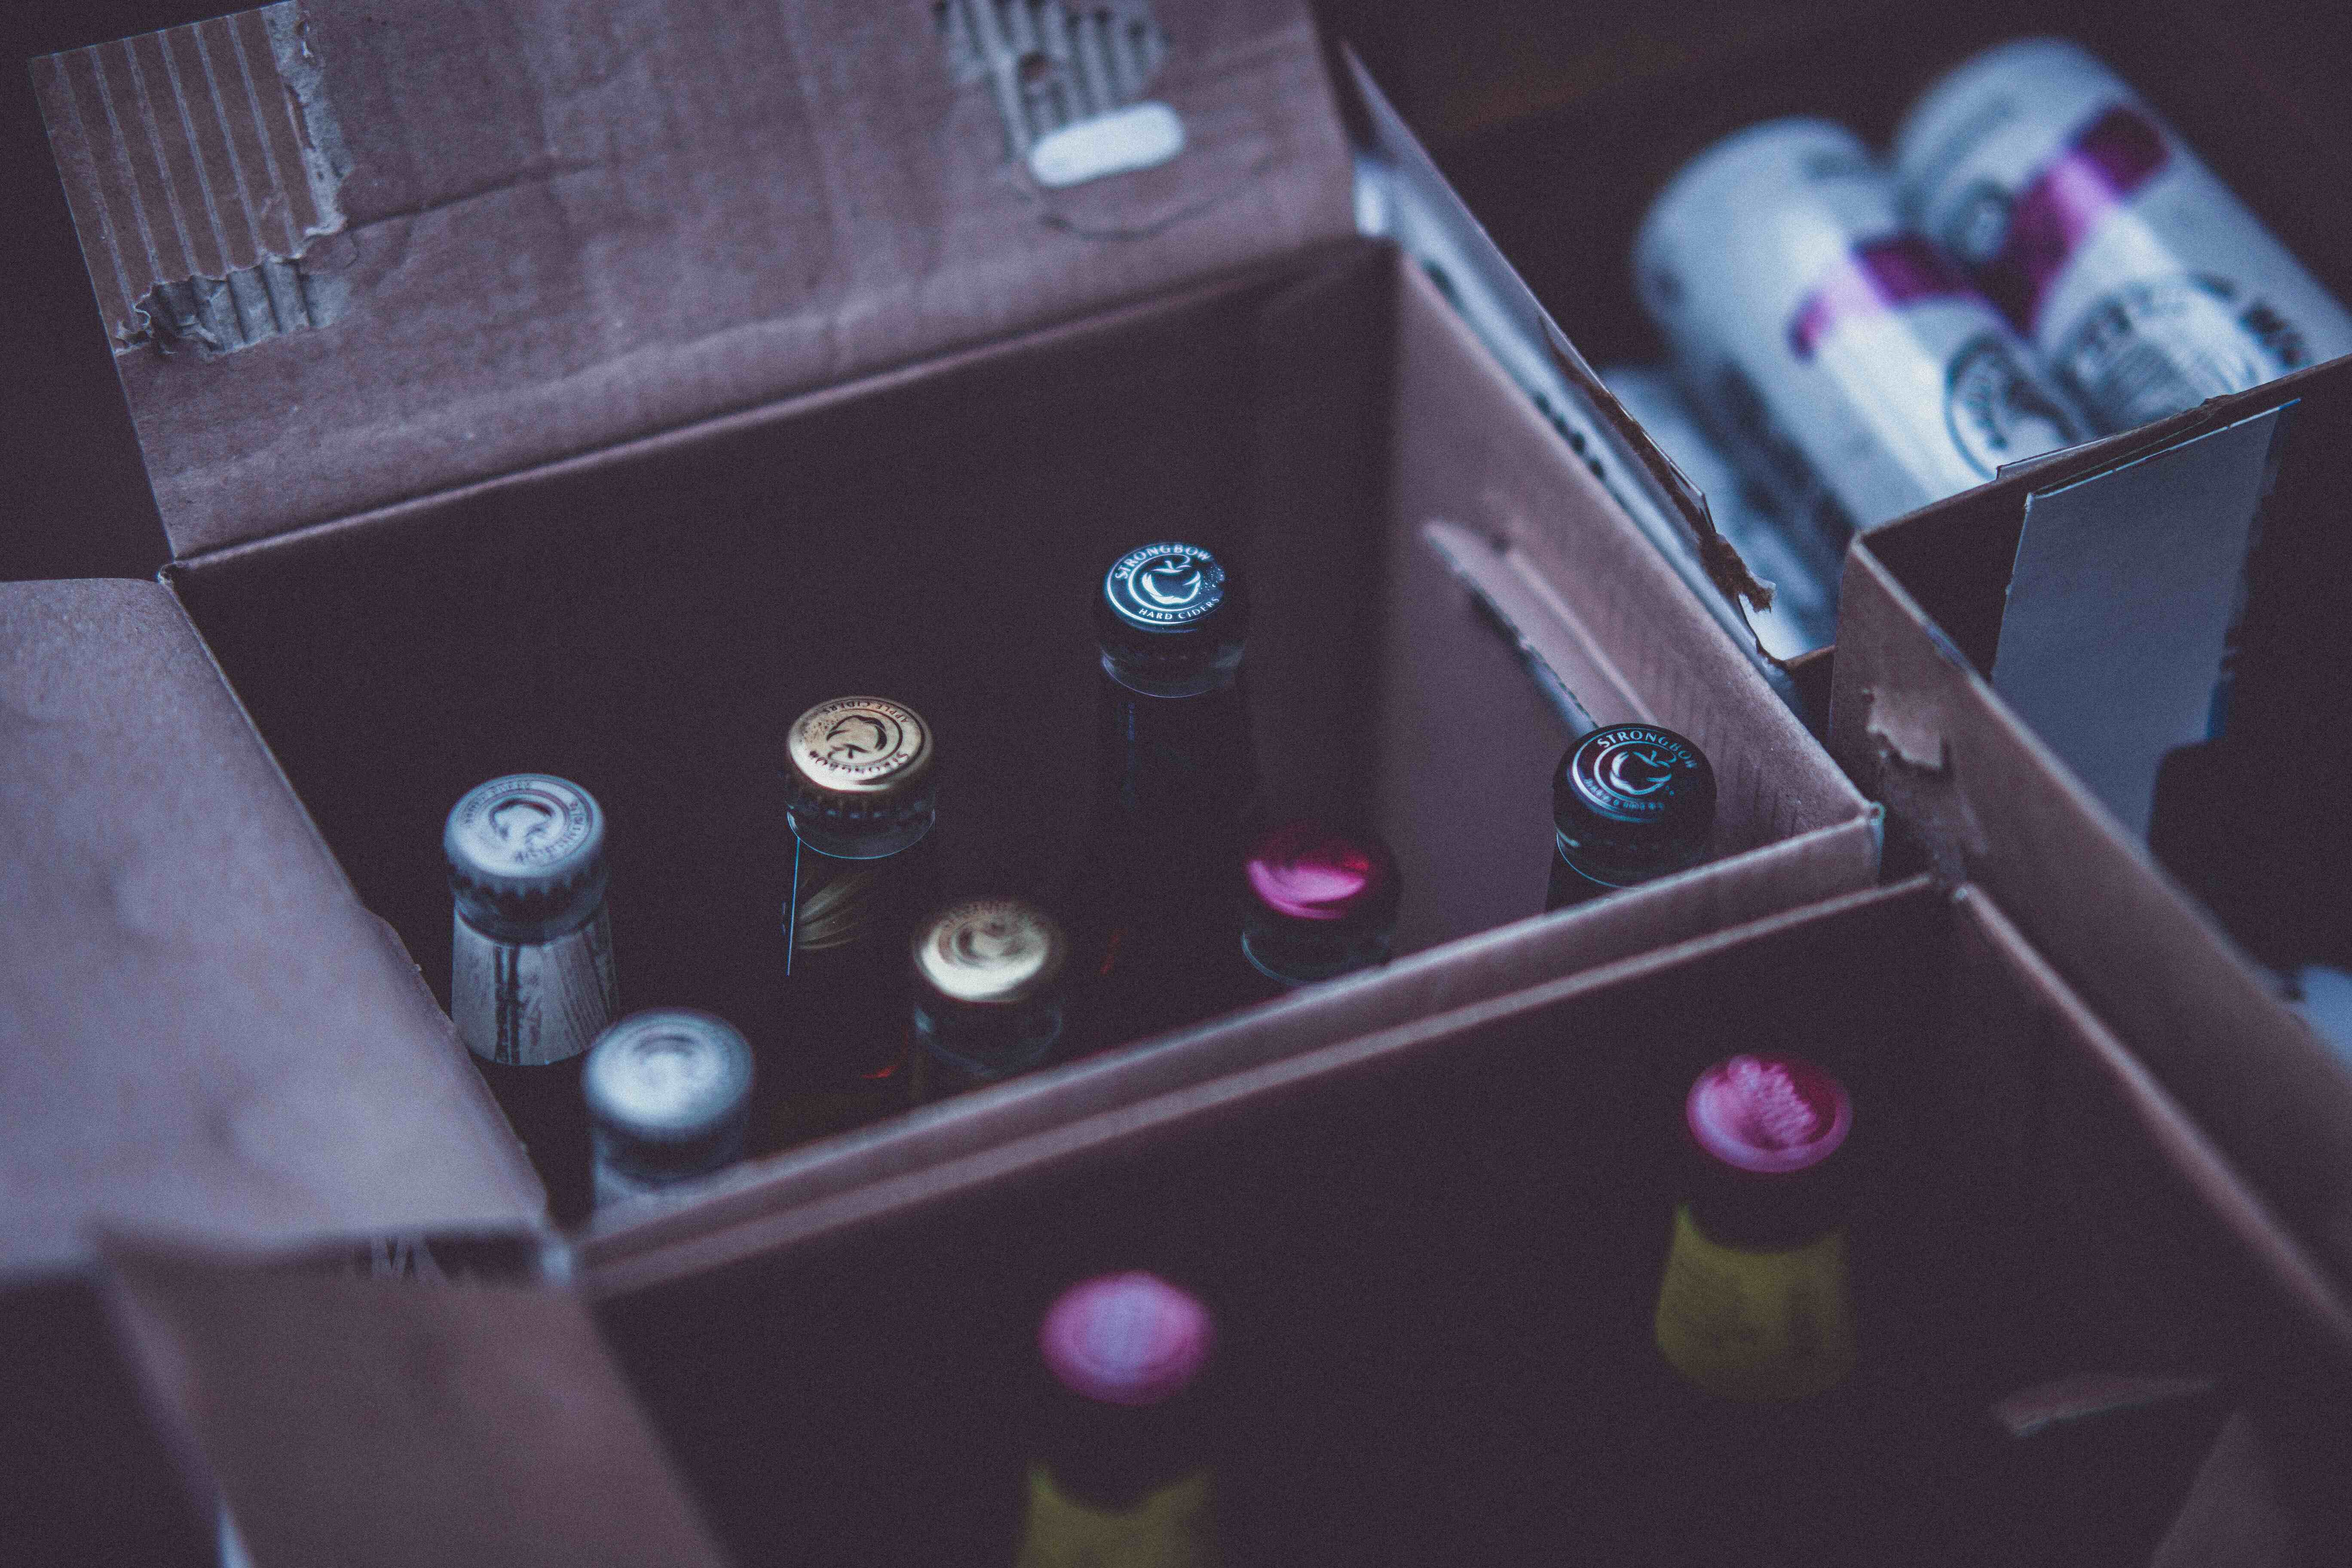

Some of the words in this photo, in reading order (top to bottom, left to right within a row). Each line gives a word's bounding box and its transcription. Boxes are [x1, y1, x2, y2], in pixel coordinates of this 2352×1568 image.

[1115, 543, 1211, 579] STRONGBOW
[1139, 608, 1173, 620] HARD
[1178, 597, 1219, 619] CIDERS
[823, 701, 870, 714] CIDERS
[877, 703, 909, 723] APPLE
[1597, 730, 1697, 768] STRONGBOW
